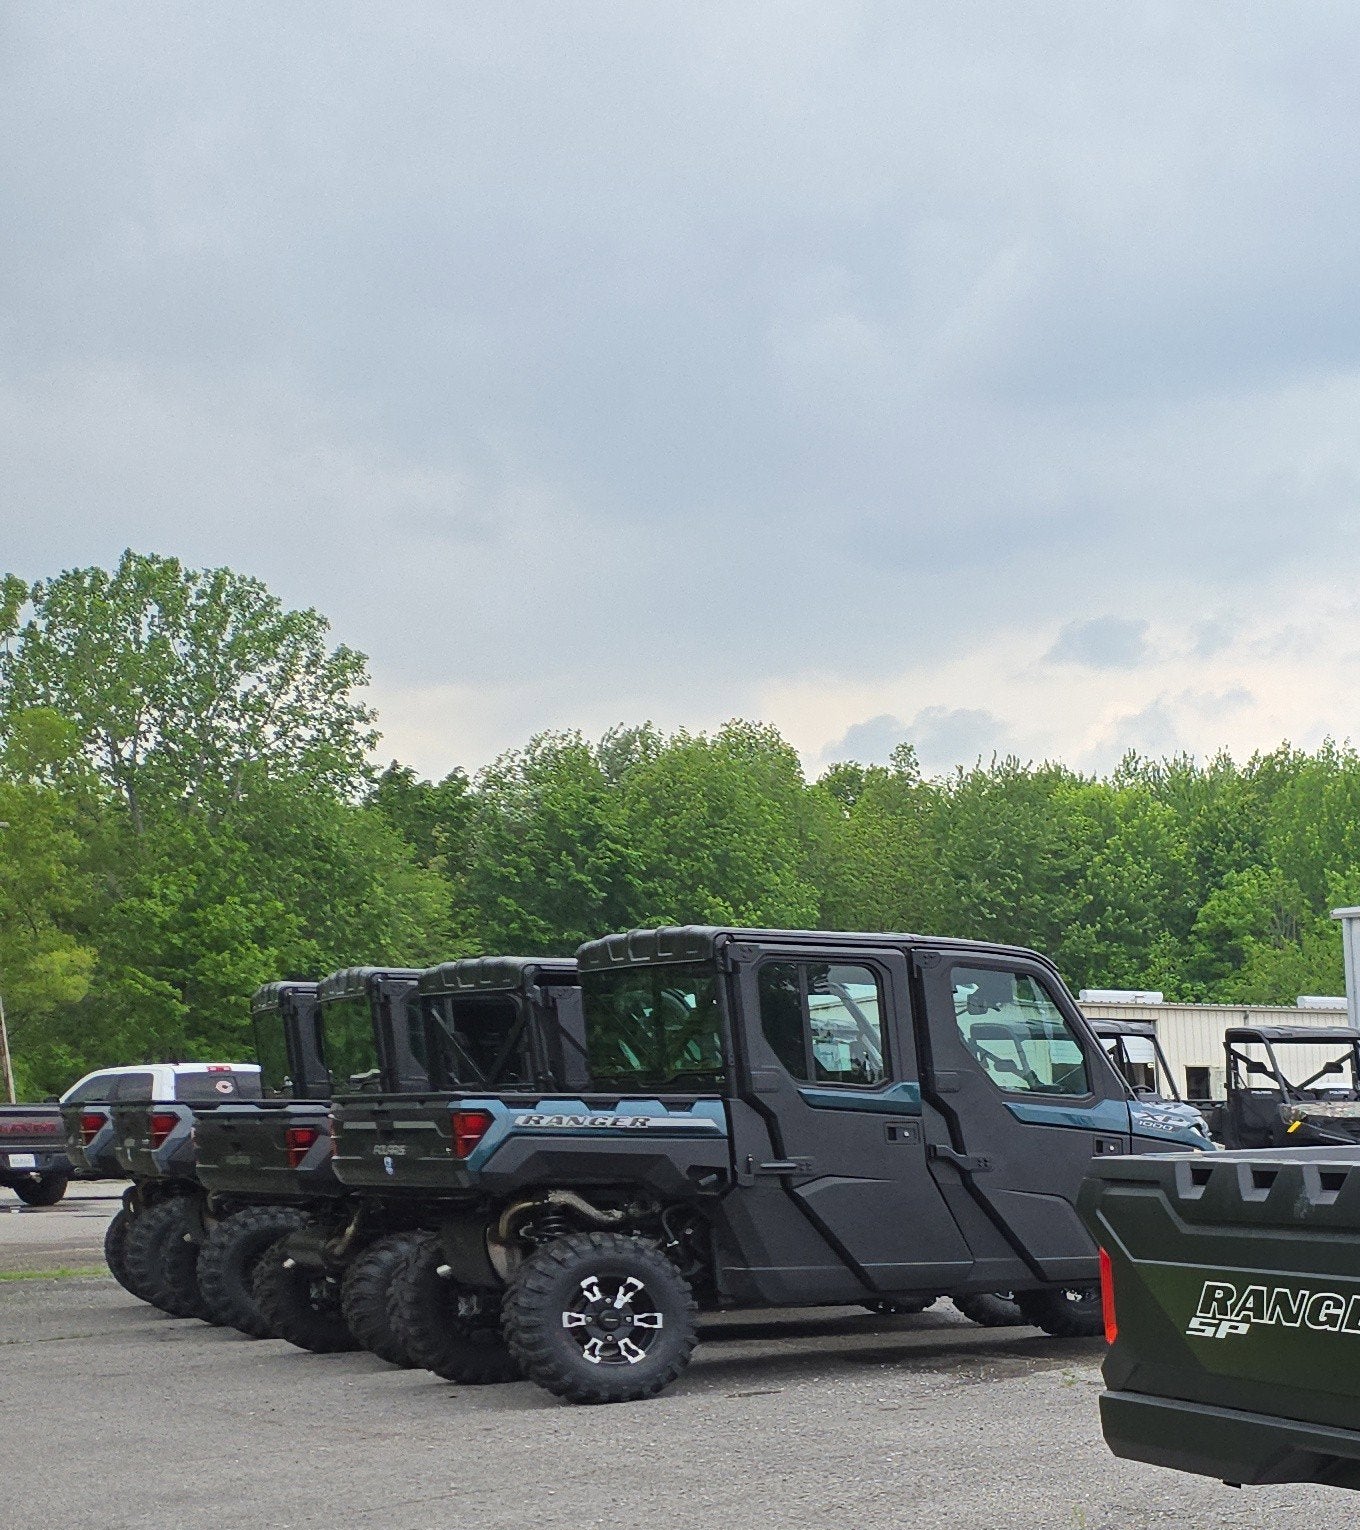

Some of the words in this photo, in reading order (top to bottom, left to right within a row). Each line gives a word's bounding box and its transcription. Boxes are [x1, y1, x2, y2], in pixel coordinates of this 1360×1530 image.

[520, 1115, 651, 1127] RANGER
[1139, 1111, 1187, 1123] XP
[1139, 1121, 1174, 1131] 1000
[1186, 1317, 1251, 1339] SP
